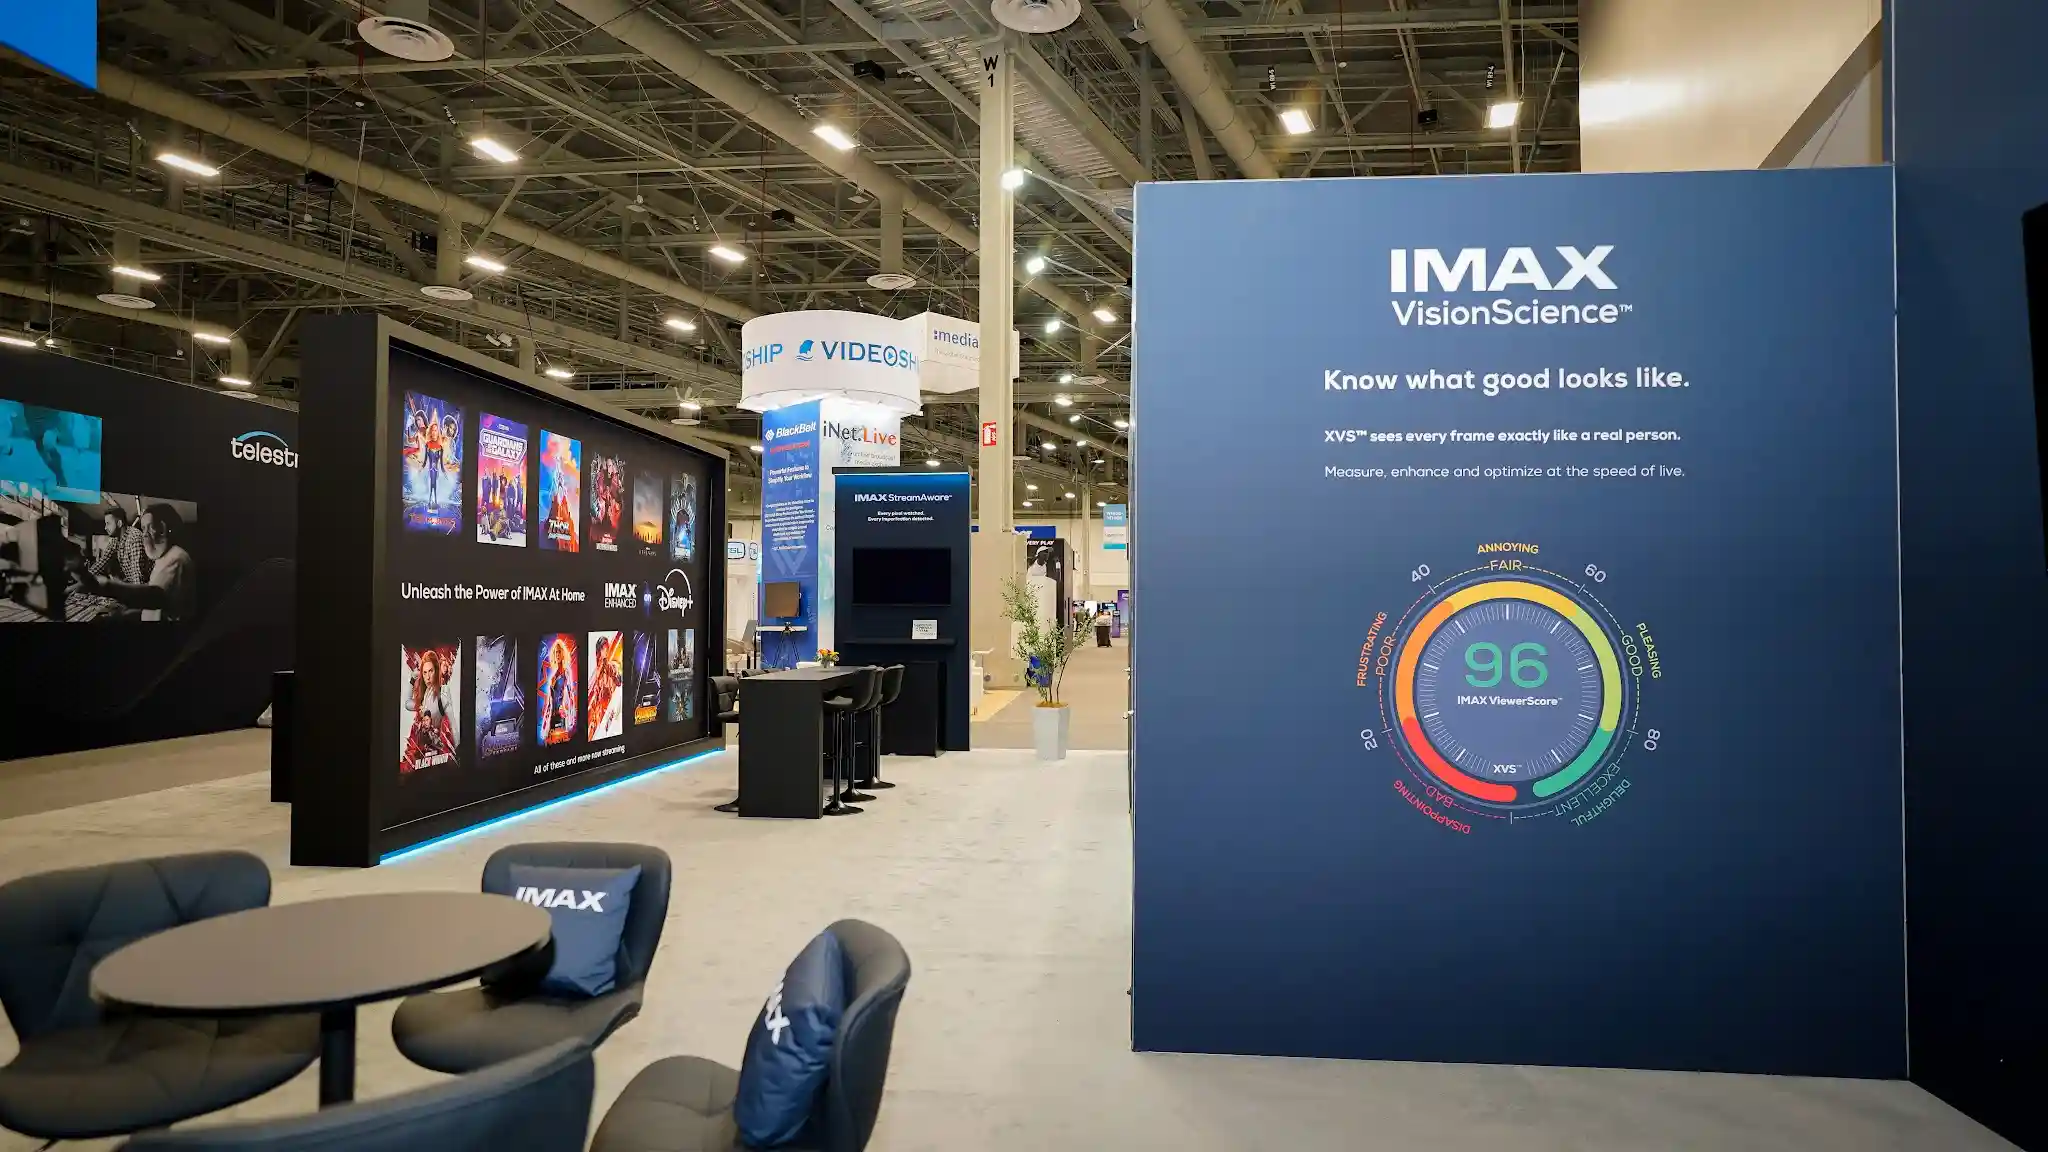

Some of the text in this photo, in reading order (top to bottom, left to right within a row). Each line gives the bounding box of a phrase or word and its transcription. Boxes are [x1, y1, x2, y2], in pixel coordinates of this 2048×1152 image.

[984, 55, 998, 71] W
[988, 74, 993, 87] 1
[1391, 245, 1618, 293] IMAX
[743, 343, 783, 370] SHIP
[1324, 367, 1690, 396] Know what good looks like.
[776, 421, 817, 438] BlackBelt
[1370, 432, 1403, 443] sees
[1405, 432, 1447, 445] every
[1450, 430, 1495, 443] frame
[1498, 430, 1551, 444] exactly
[1553, 429, 1578, 441] like
[1580, 432, 1591, 441] a
[1594, 428, 1623, 441] real
[1626, 430, 1681, 444] person.
[1325, 464, 1685, 481] Measure, enhance and optimize at the speed of live.
[854, 493, 887, 502] IMAX
[1477, 542, 1539, 554] ANNOYING
[1410, 563, 1431, 583] 40
[1489, 559, 1522, 571] FAIR
[1584, 563, 1606, 584] 60
[401, 582, 586, 602] Unleash the Power of IMAX At Home
[604, 582, 637, 598] IMAX
[604, 598, 637, 608] ENHANCED
[1356, 610, 1388, 687] FRUSTRATING
[1375, 635, 1396, 676] POOR
[1621, 634, 1643, 677] GOOD
[1635, 622, 1662, 679] PLEASING
[1464, 641, 1549, 689] 96
[1457, 695, 1487, 705] IMAX
[1360, 728, 1378, 751] 20
[1643, 728, 1661, 751] 80
[542, 763, 549, 772] of
[550, 760, 565, 770] these
[566, 756, 576, 765] and
[577, 753, 591, 763] more
[1425, 785, 1454, 808] BAD
[1555, 763, 1621, 817] EXCELLENT
[1393, 779, 1471, 834] DISAPPOINTING
[1571, 779, 1632, 827] DELIGHTFUL
[515, 886, 607, 912] IMAX
